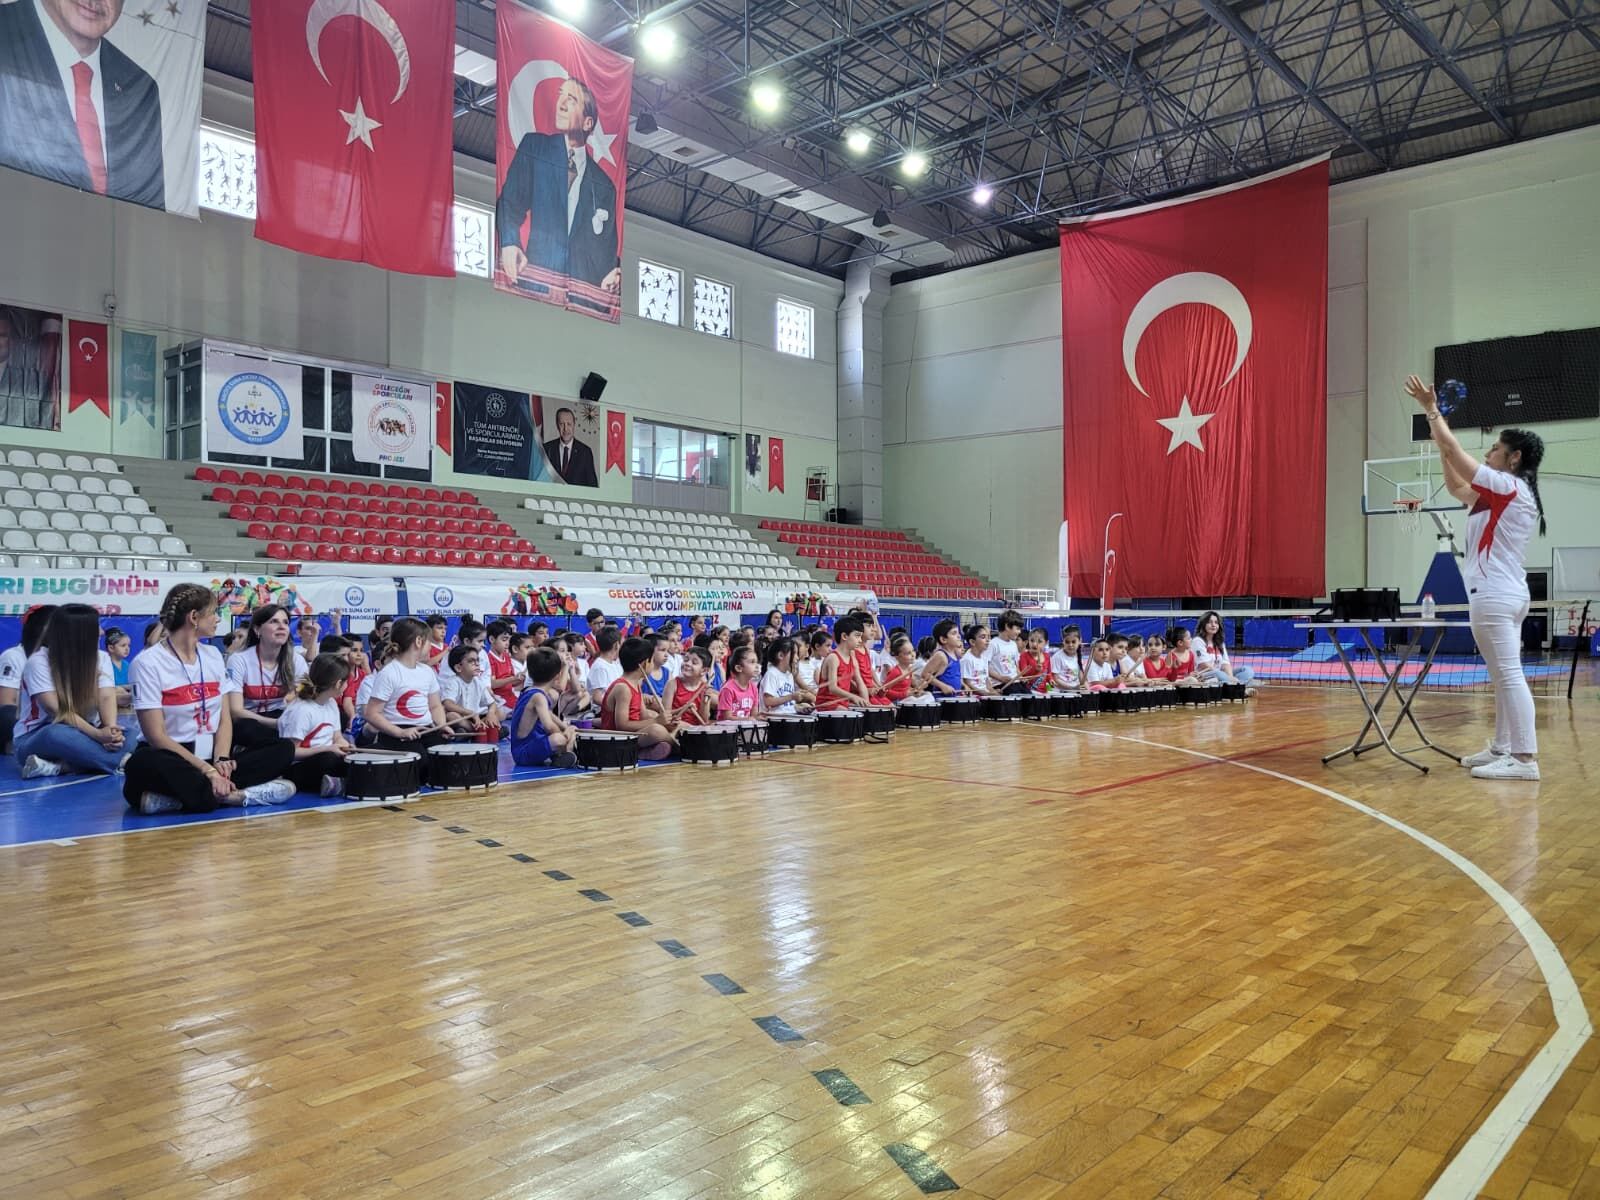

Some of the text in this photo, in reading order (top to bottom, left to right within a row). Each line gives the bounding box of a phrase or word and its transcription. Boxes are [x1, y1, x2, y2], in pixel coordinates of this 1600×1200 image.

[31, 574, 160, 595] BUGÜNÜN
[608, 587, 756, 599] GELECEĞİN SPORCULARI PROJESİ
[629, 601, 664, 612] ÇOCUK
